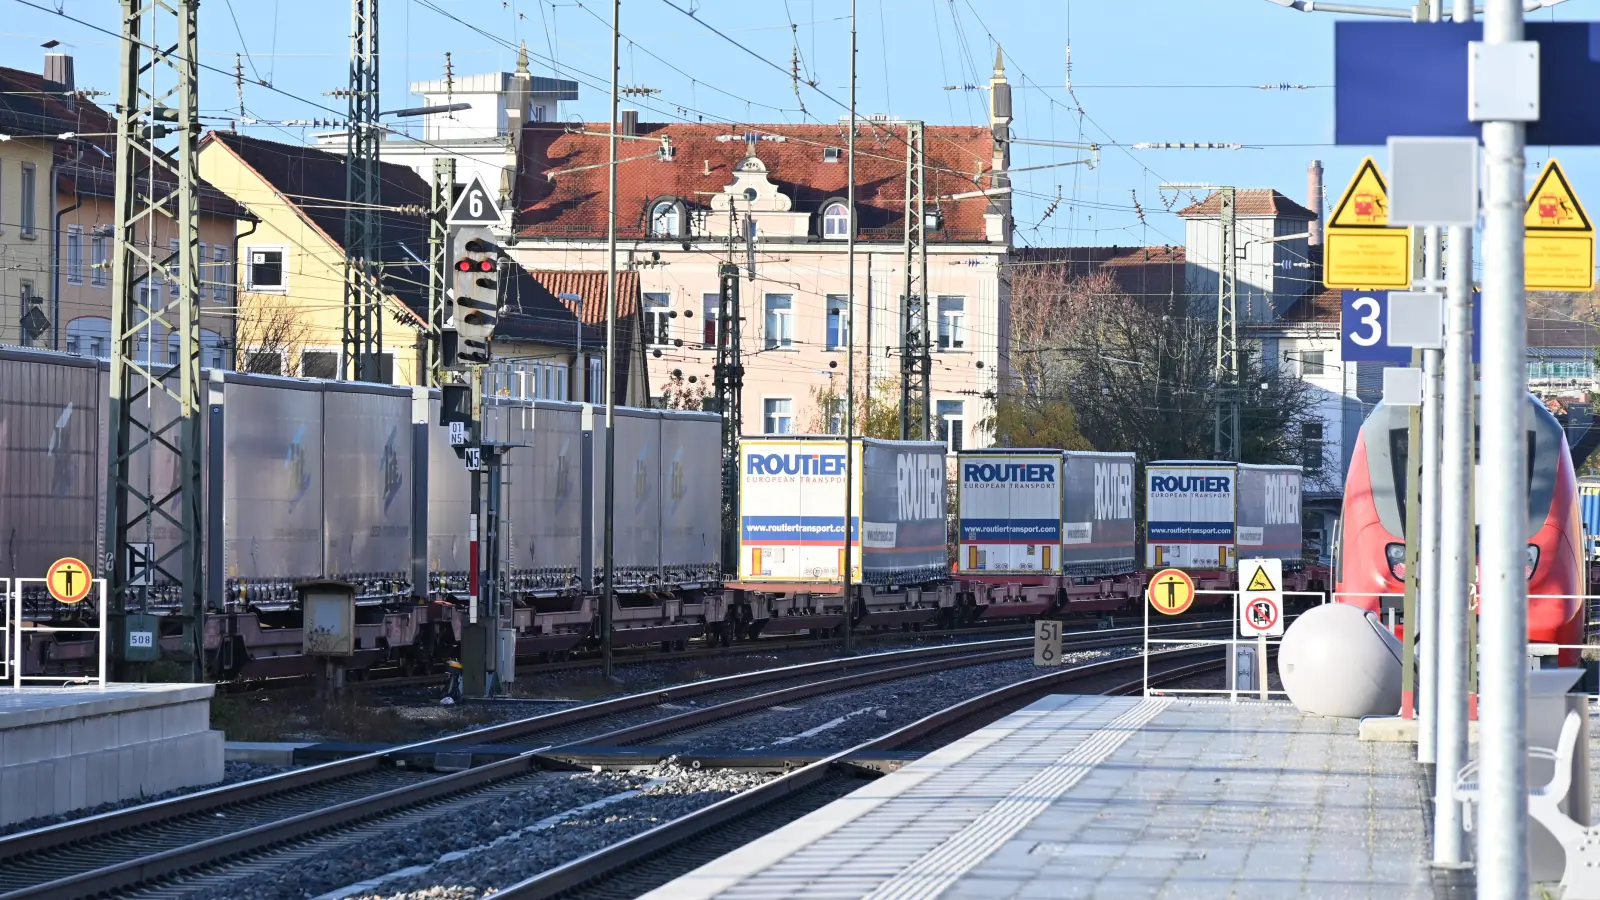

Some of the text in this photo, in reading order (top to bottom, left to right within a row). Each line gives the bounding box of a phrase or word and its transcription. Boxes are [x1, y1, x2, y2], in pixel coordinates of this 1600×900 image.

[469, 189, 483, 217] 6
[1350, 297, 1382, 346] 3
[451, 434, 462, 444] N5
[465, 450, 479, 468] N5
[964, 525, 1056, 534] www.routiertransport.com
[1151, 527, 1231, 535] www.routiertransport.com
[131, 635, 151, 645] 508
[1040, 623, 1058, 641] 51
[1042, 643, 1054, 662] 6
